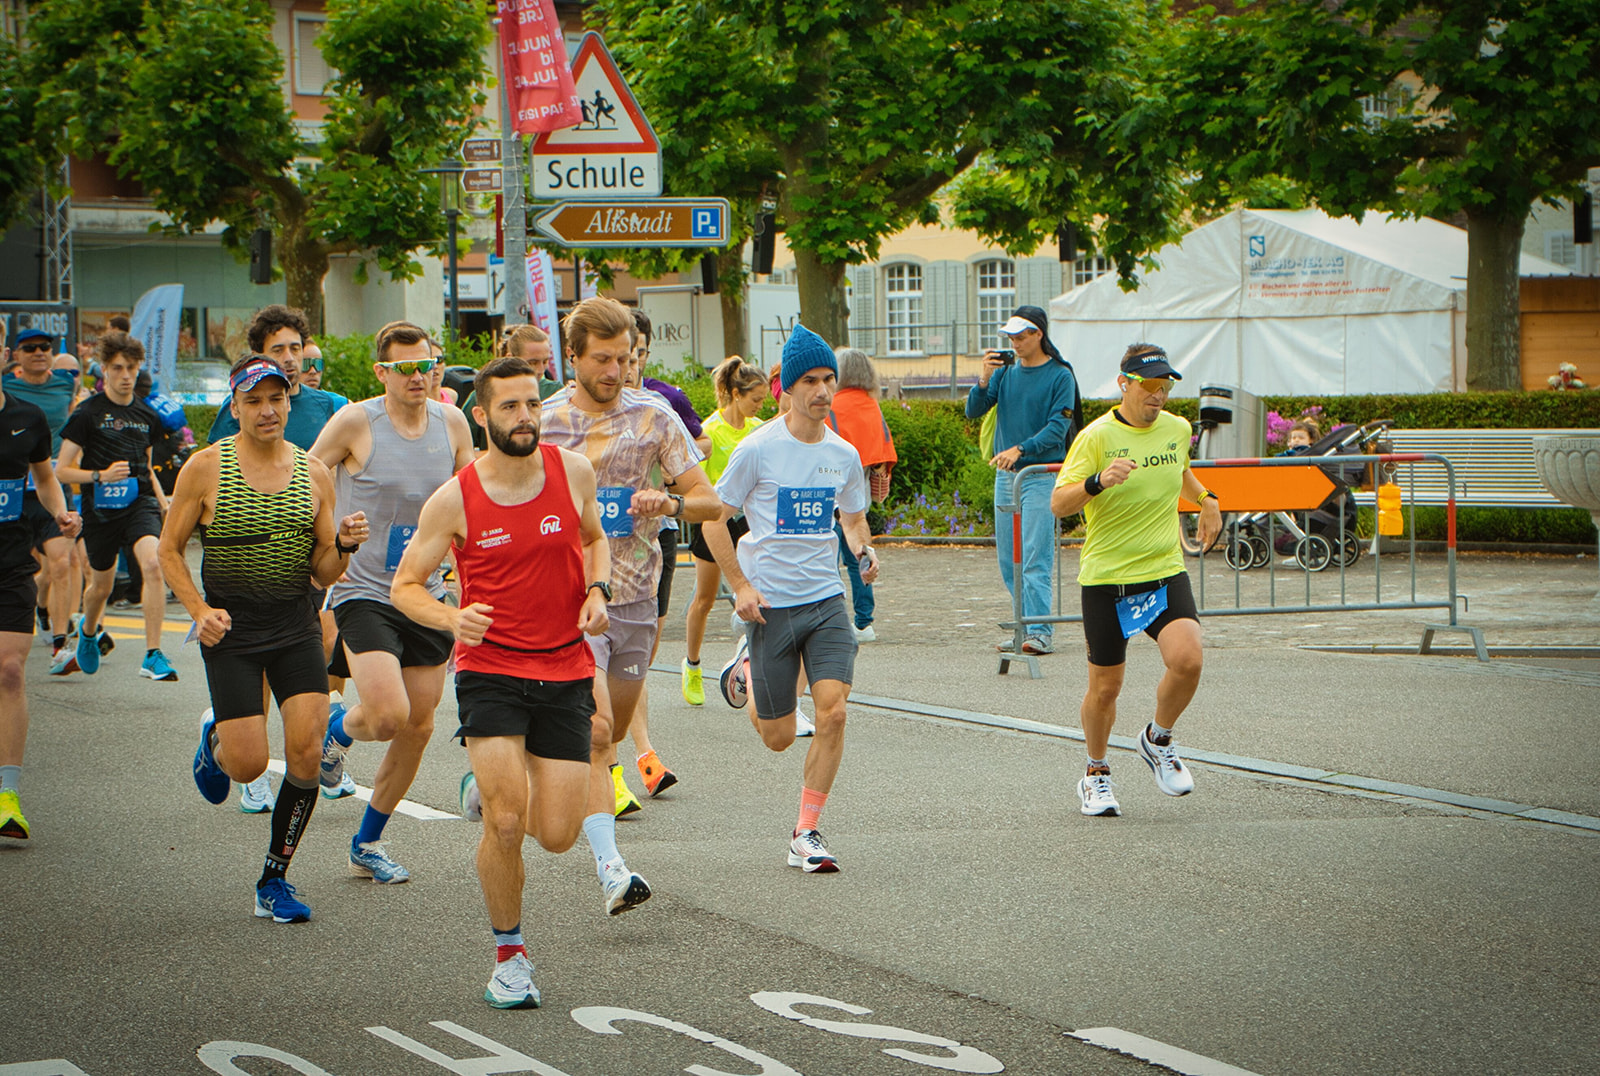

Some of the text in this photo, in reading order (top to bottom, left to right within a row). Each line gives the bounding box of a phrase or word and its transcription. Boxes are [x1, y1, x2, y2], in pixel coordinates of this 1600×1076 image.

[547, 158, 645, 190] Schule
[585, 208, 673, 234] Altstadt
[1142, 453, 1178, 468] JOHN
[103, 486, 128, 498] 237
[793, 501, 823, 518] 156
[1130, 593, 1157, 620] 242
